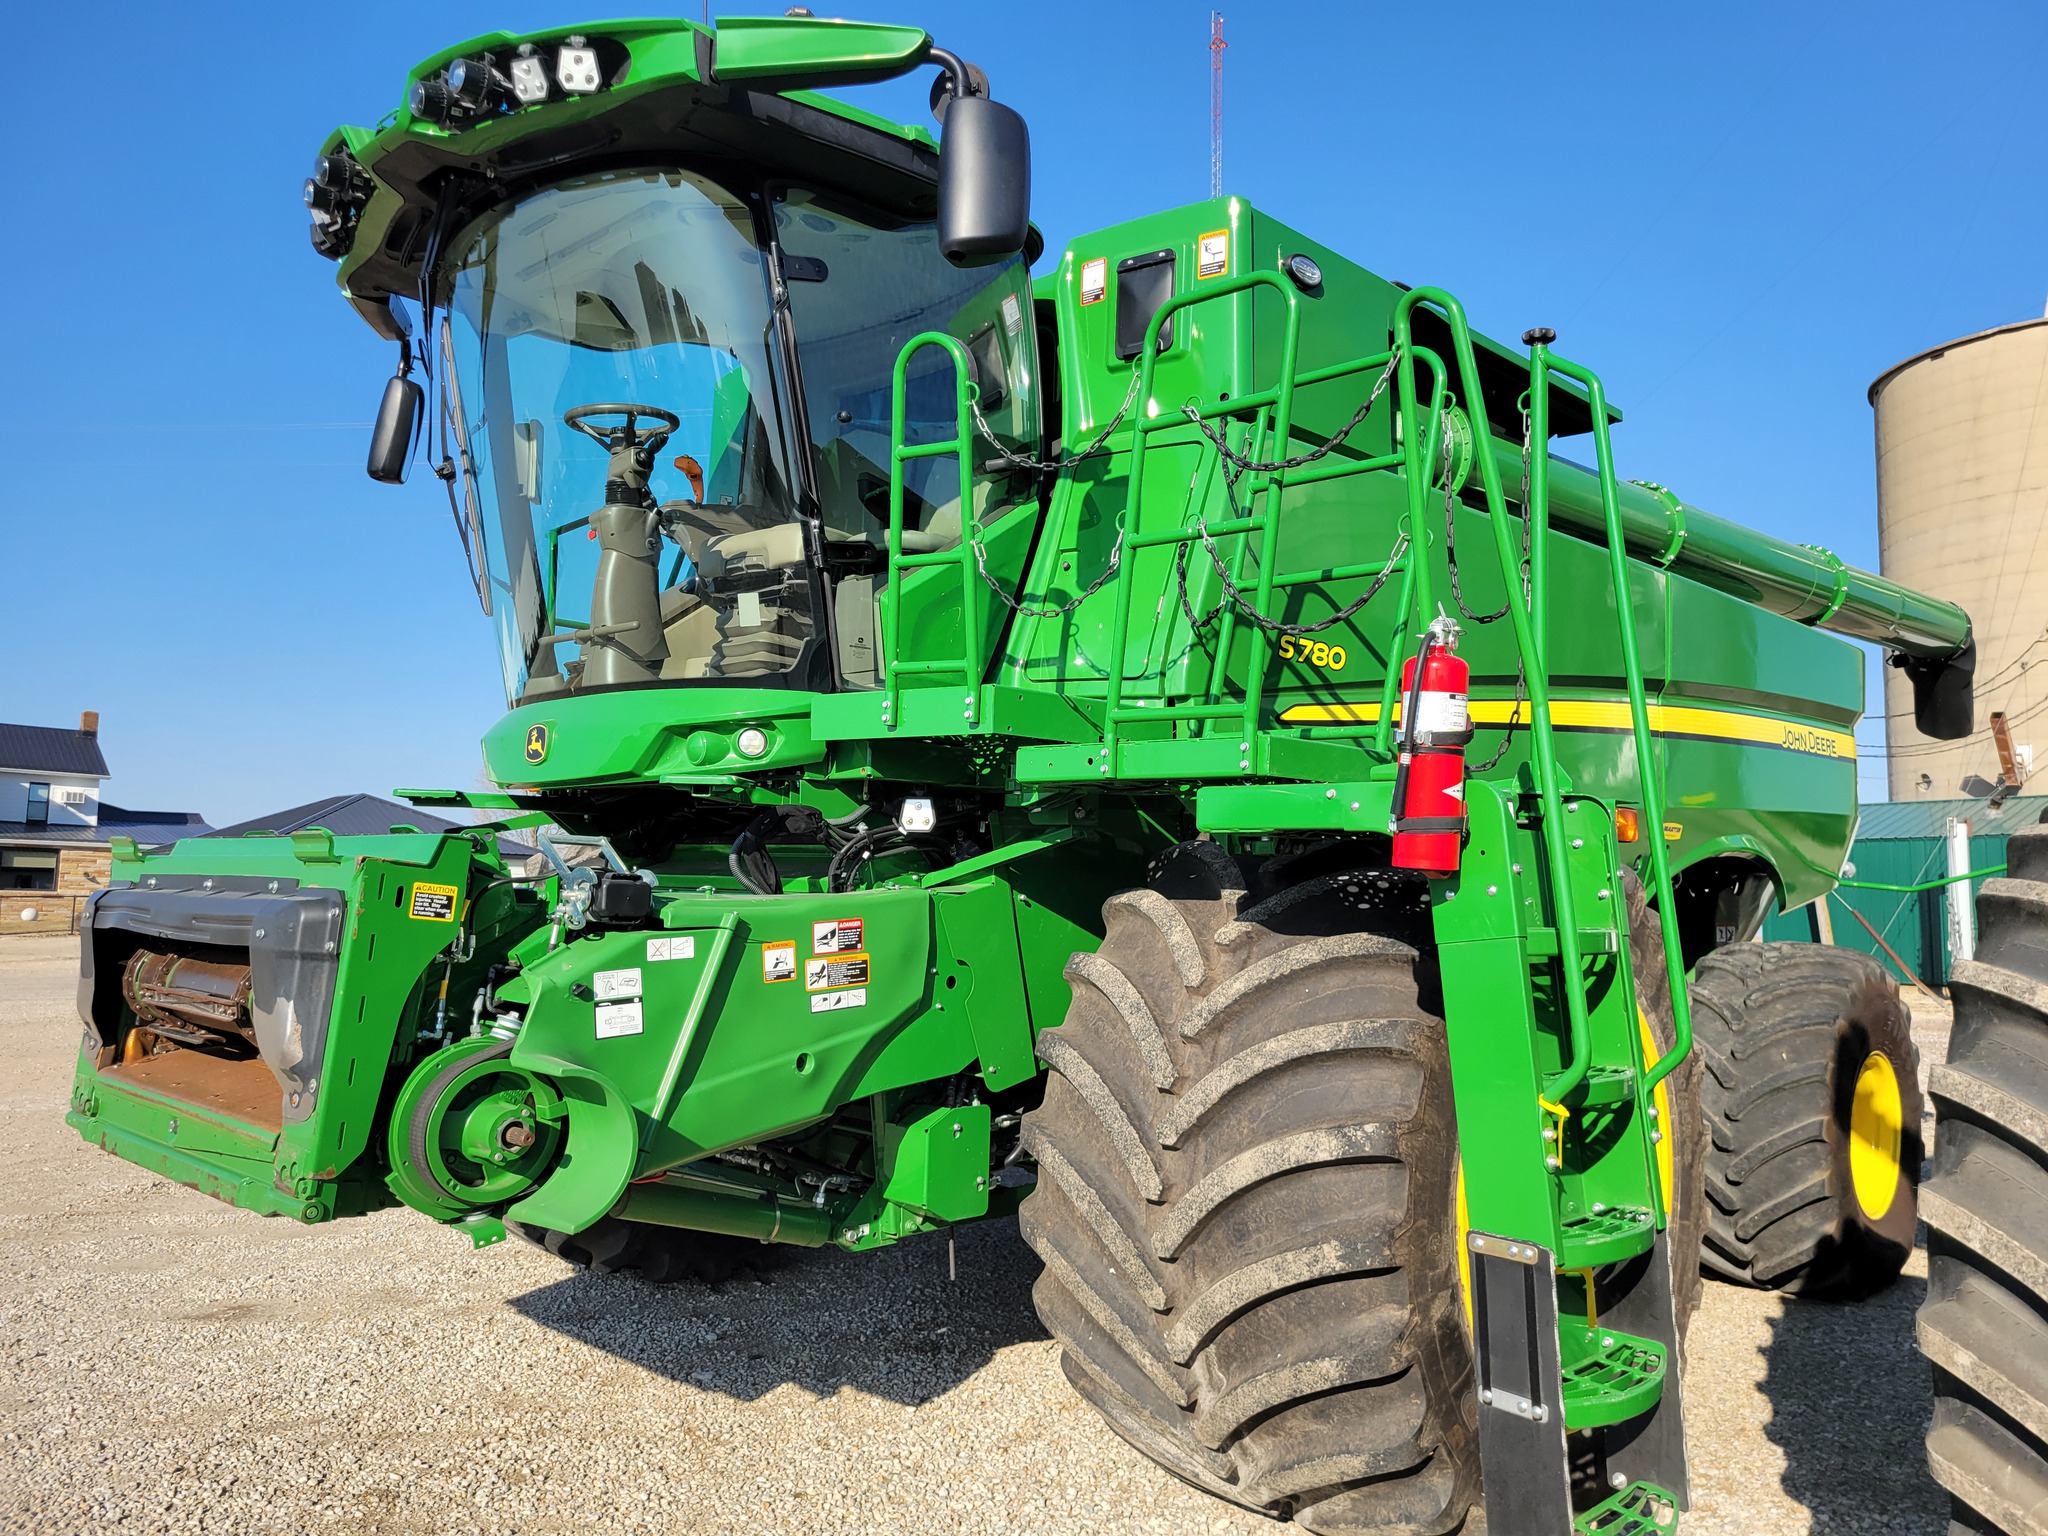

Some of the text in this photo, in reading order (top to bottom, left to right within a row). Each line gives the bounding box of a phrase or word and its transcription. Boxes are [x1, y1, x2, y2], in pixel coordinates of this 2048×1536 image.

[1278, 633, 1347, 671] S780
[1782, 725, 1837, 754] JOHN DEERE
[422, 884, 456, 894] CAUTION
